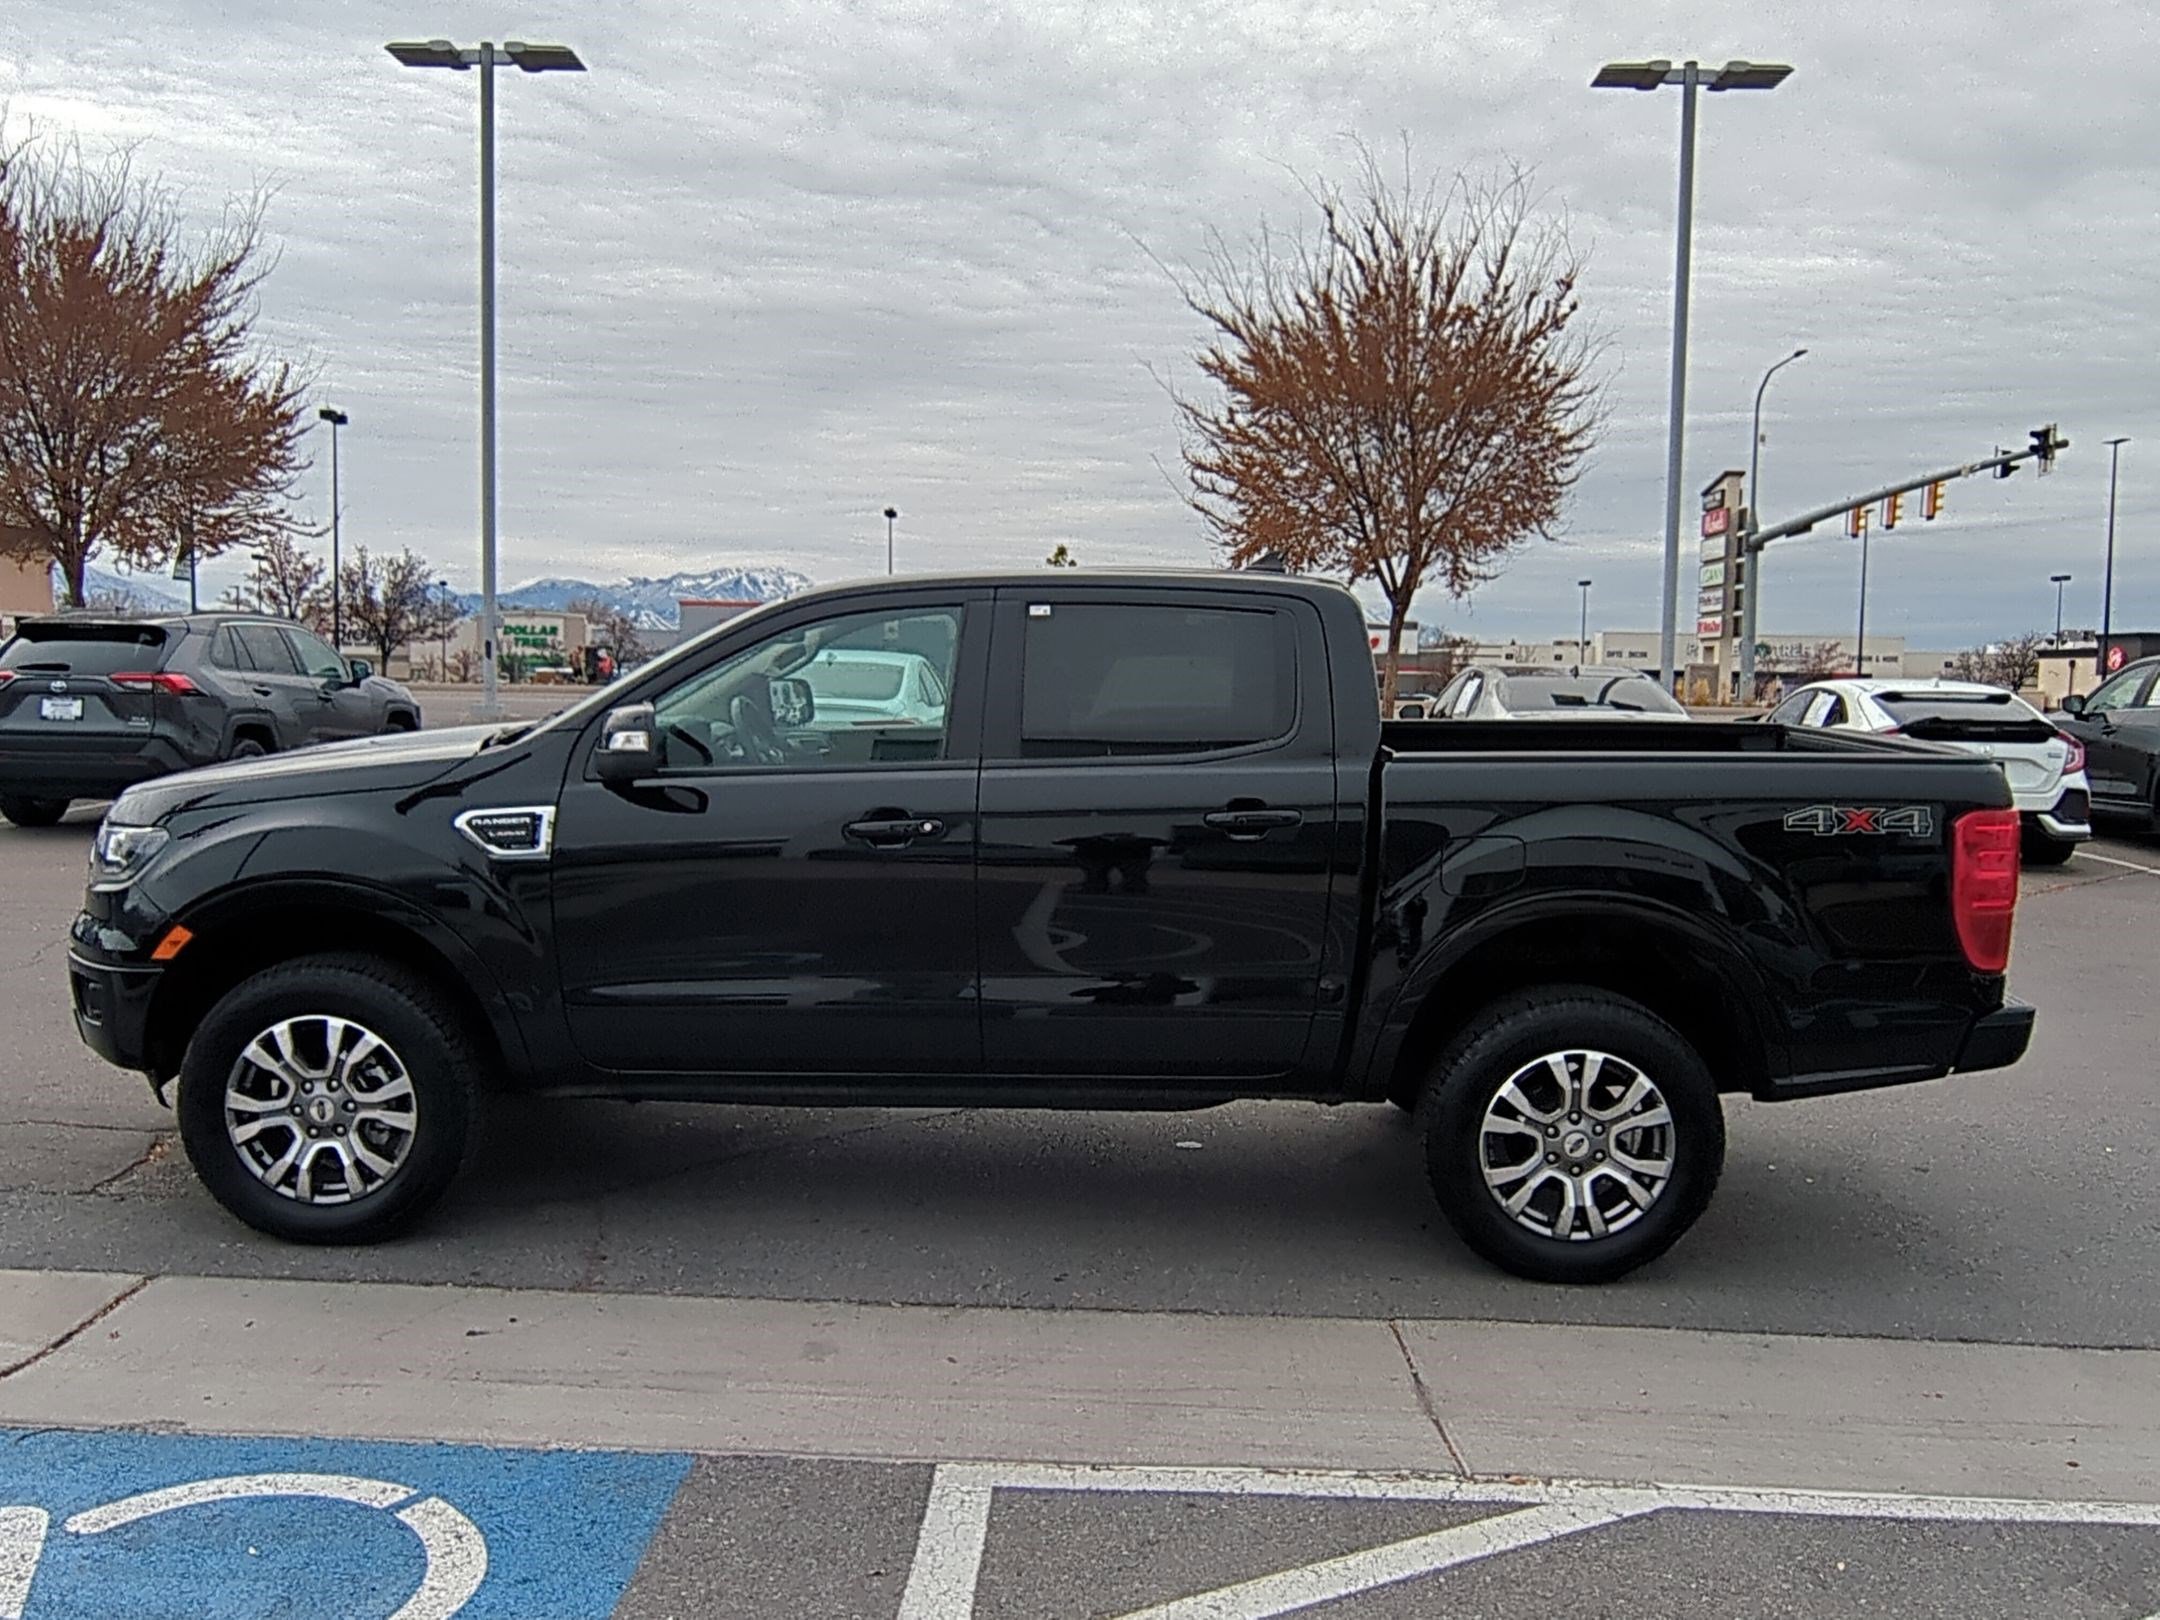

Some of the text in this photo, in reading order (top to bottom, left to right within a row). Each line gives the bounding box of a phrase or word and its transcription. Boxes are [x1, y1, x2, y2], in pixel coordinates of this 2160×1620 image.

[503, 625, 558, 635] DOLLAR
[514, 637, 547, 647] TREE
[471, 816, 531, 826] RANGER
